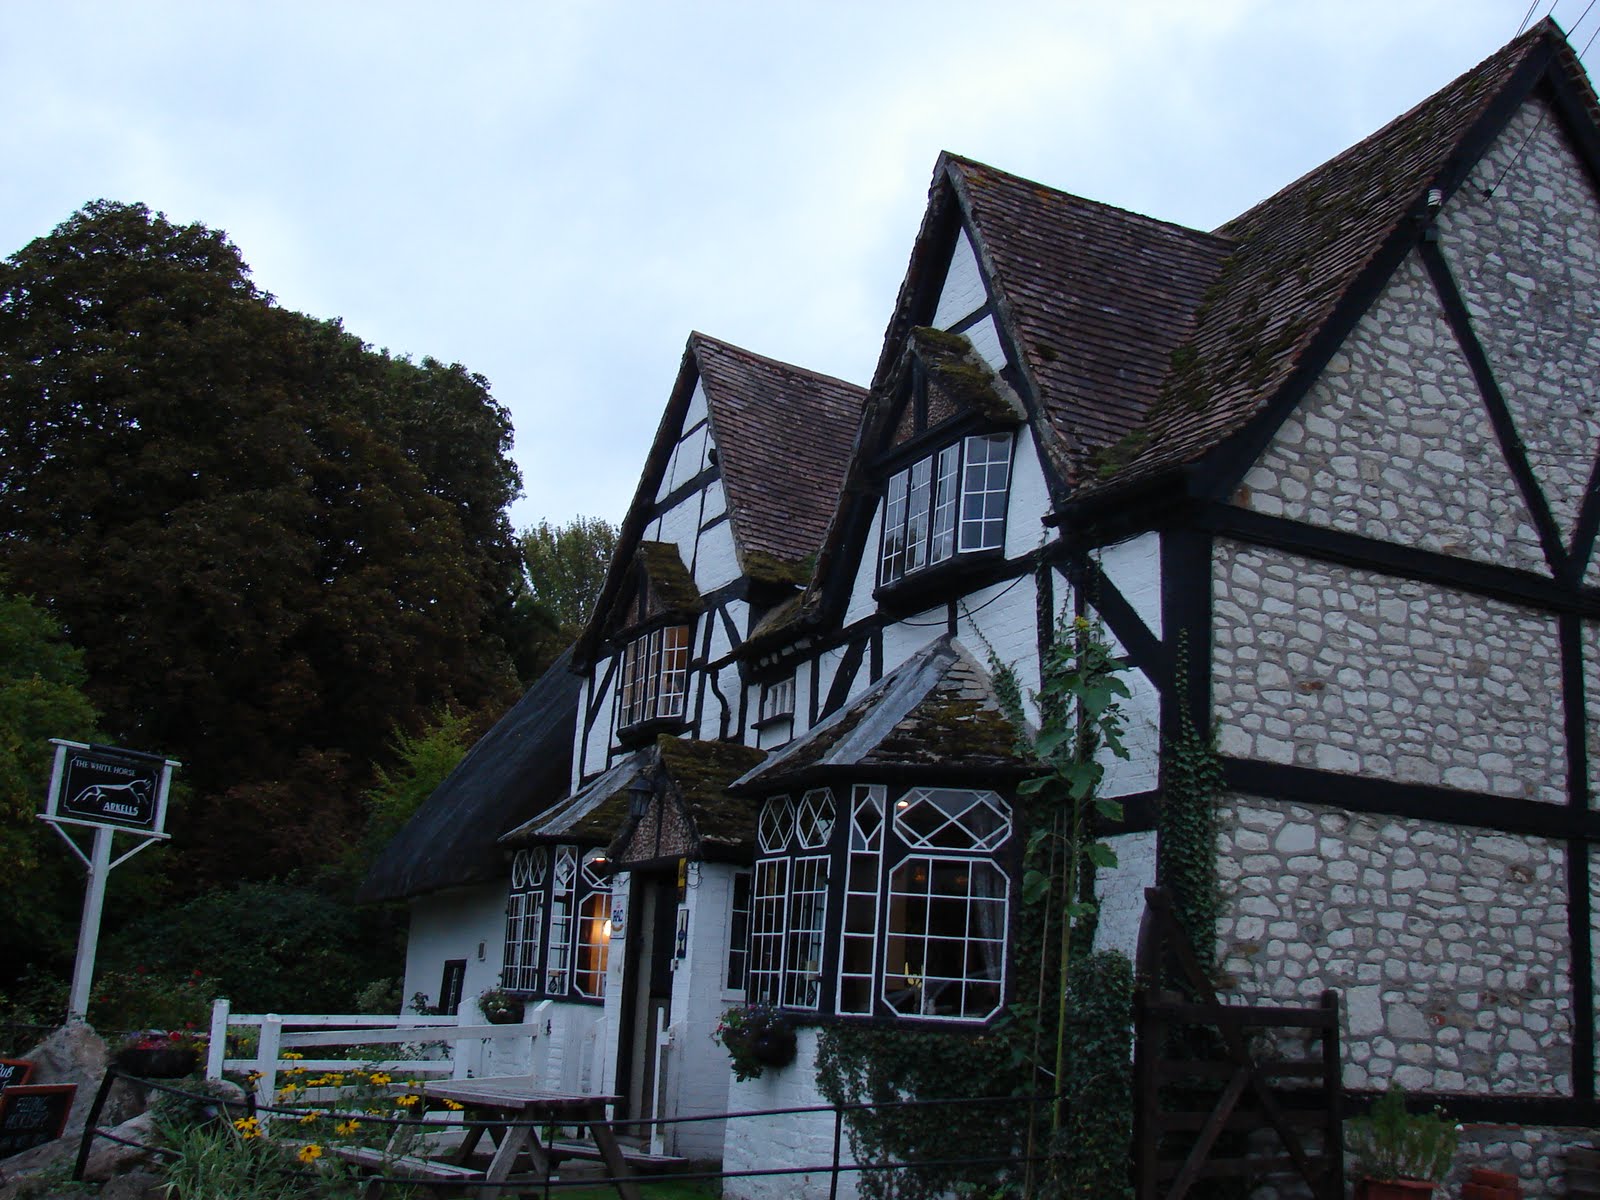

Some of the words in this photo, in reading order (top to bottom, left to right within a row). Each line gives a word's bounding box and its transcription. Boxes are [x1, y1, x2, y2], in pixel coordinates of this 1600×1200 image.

[75, 759, 88, 768] THE
[90, 762, 112, 772] WHITE
[113, 766, 136, 777] HORSE
[102, 801, 139, 816] ARKELLS
